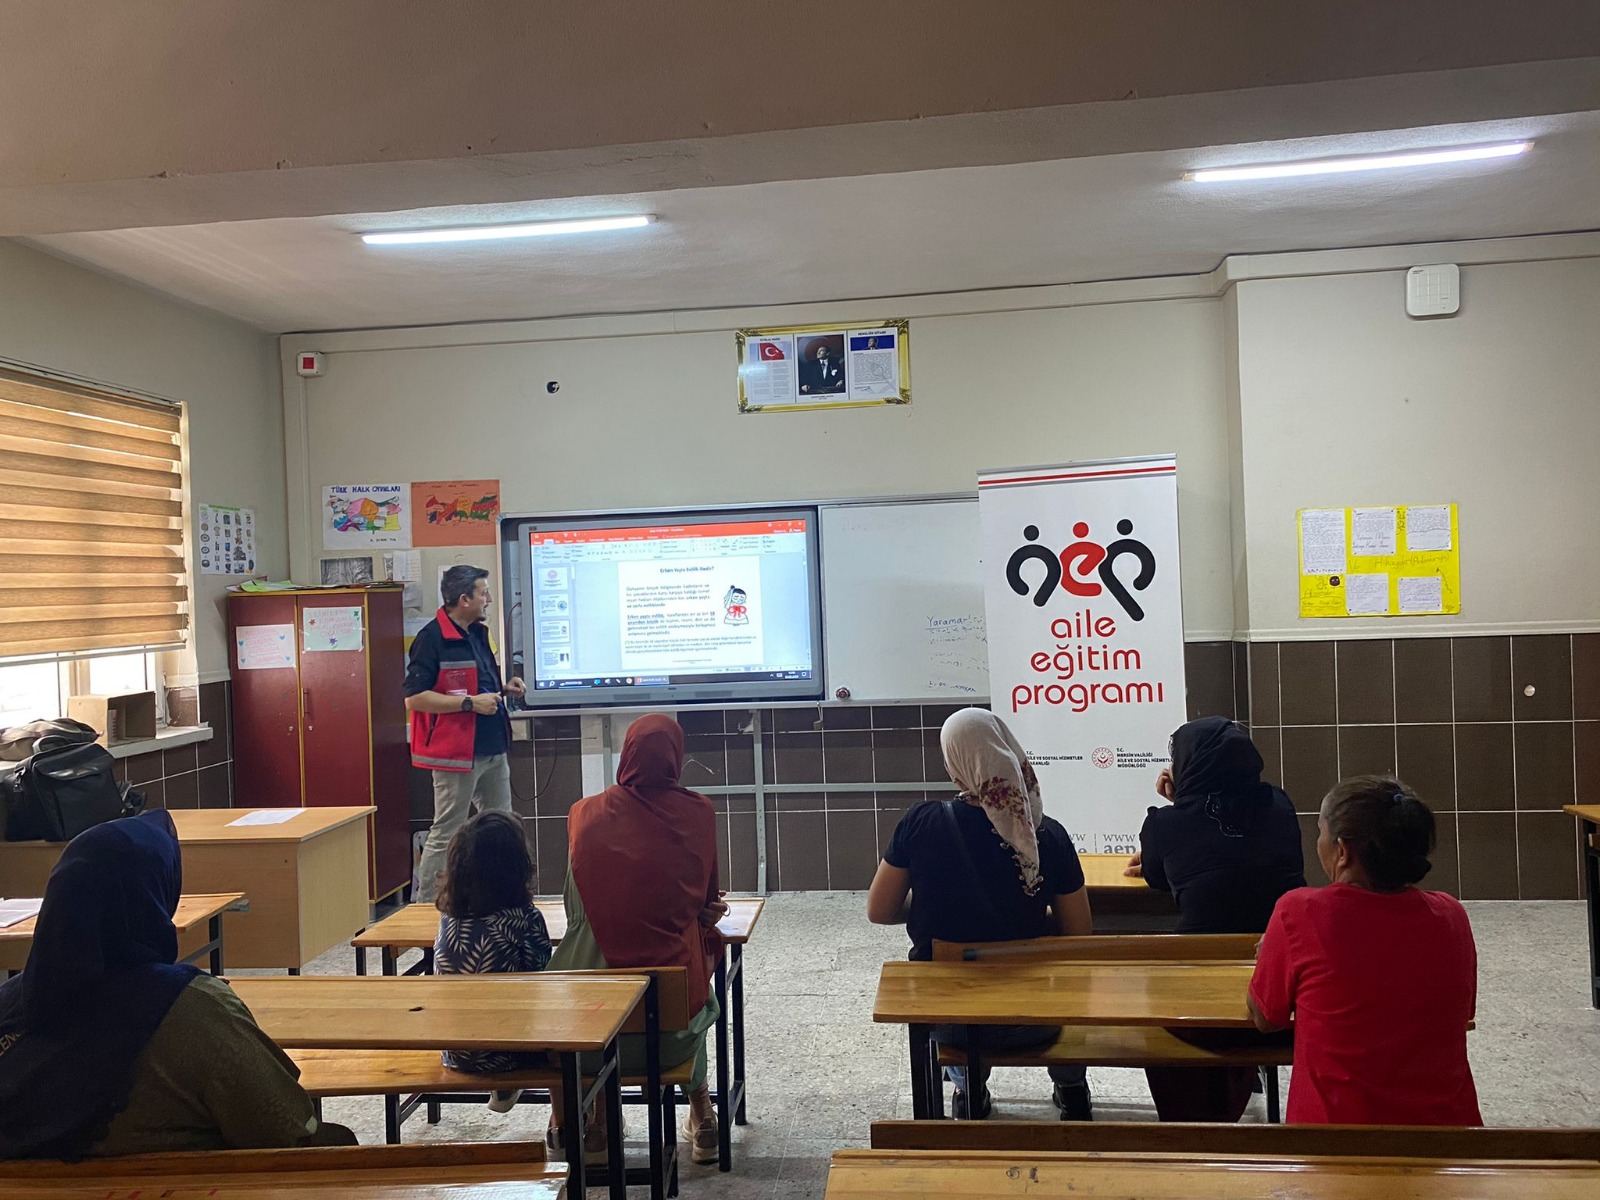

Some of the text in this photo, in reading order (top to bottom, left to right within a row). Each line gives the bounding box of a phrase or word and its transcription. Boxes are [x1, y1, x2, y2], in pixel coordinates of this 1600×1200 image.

[331, 485, 348, 493] TÜRK
[1050, 609, 1116, 639] aile
[1030, 644, 1141, 680] eğitim
[1012, 682, 1163, 713] programı
[1103, 834, 1135, 842] www
